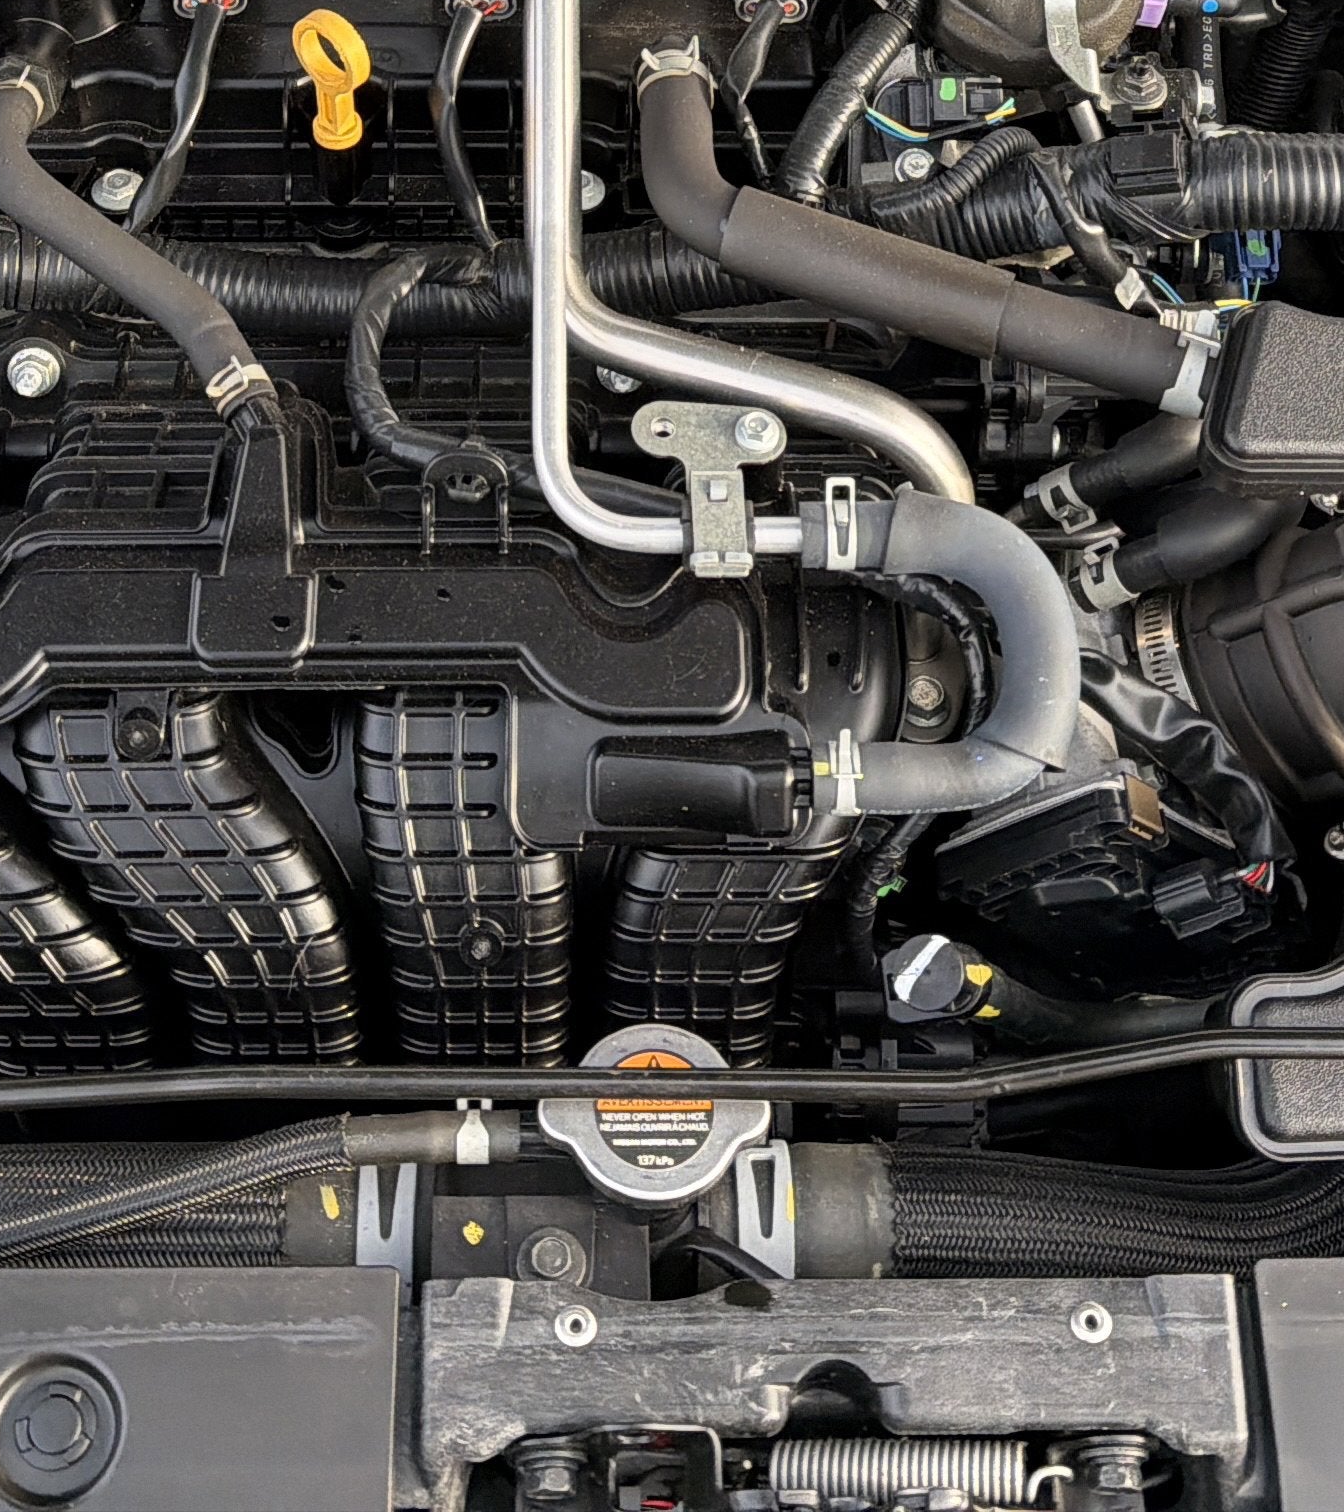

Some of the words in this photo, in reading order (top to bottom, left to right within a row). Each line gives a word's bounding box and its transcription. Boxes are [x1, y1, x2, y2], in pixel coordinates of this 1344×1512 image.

[601, 1113, 631, 1121] NEVER
[632, 1113, 656, 1121] OPEN
[658, 1113, 686, 1121] WHEN
[637, 1155, 656, 1166] 137
